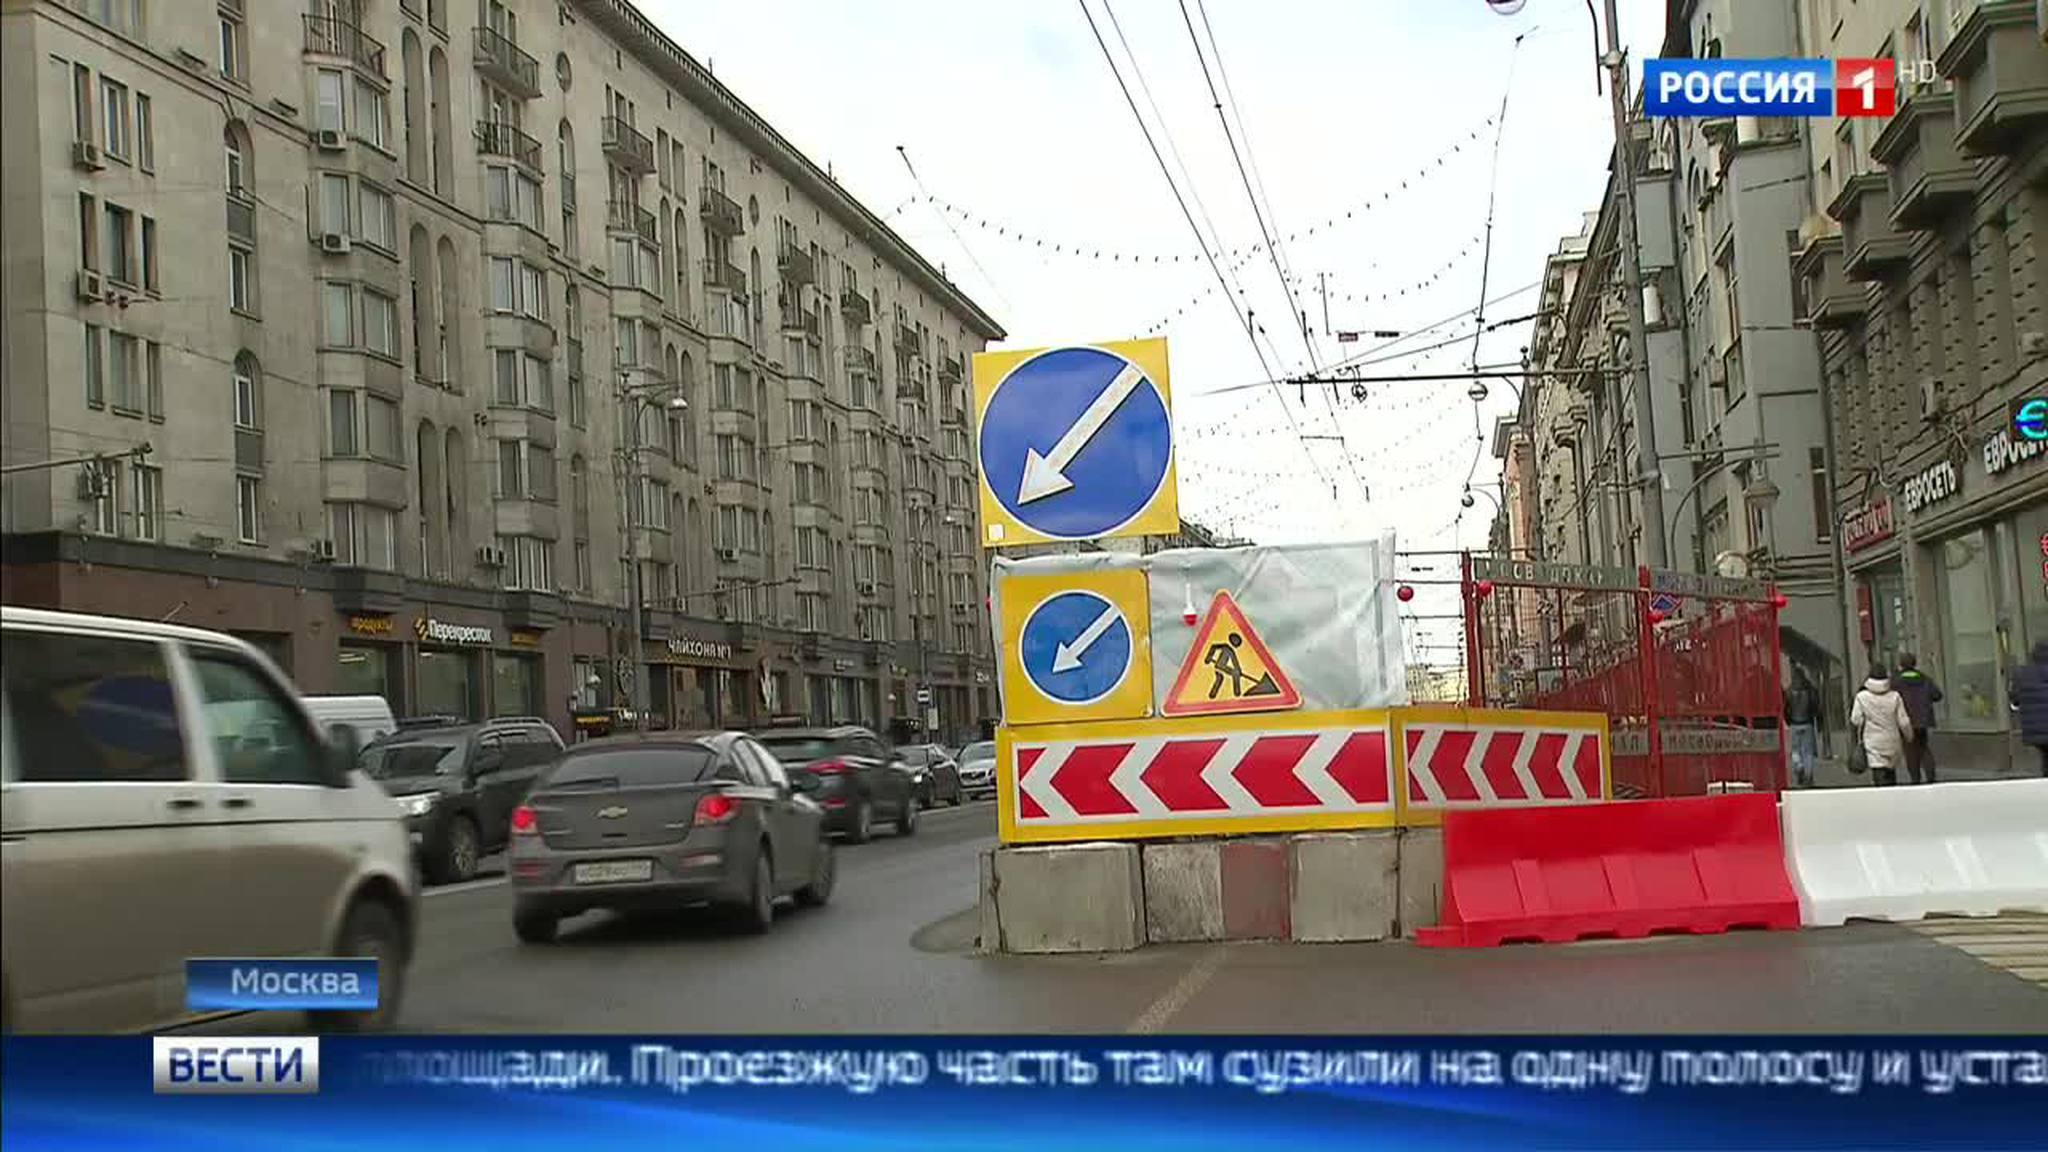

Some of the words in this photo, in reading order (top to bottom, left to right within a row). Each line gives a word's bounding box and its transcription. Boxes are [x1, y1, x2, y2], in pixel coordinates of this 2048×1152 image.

[1905, 460, 1956, 513] ЕВРОСЕТЬ
[428, 619, 492, 644] Перекресток
[668, 638, 716, 658] ЧАЙХОНА
